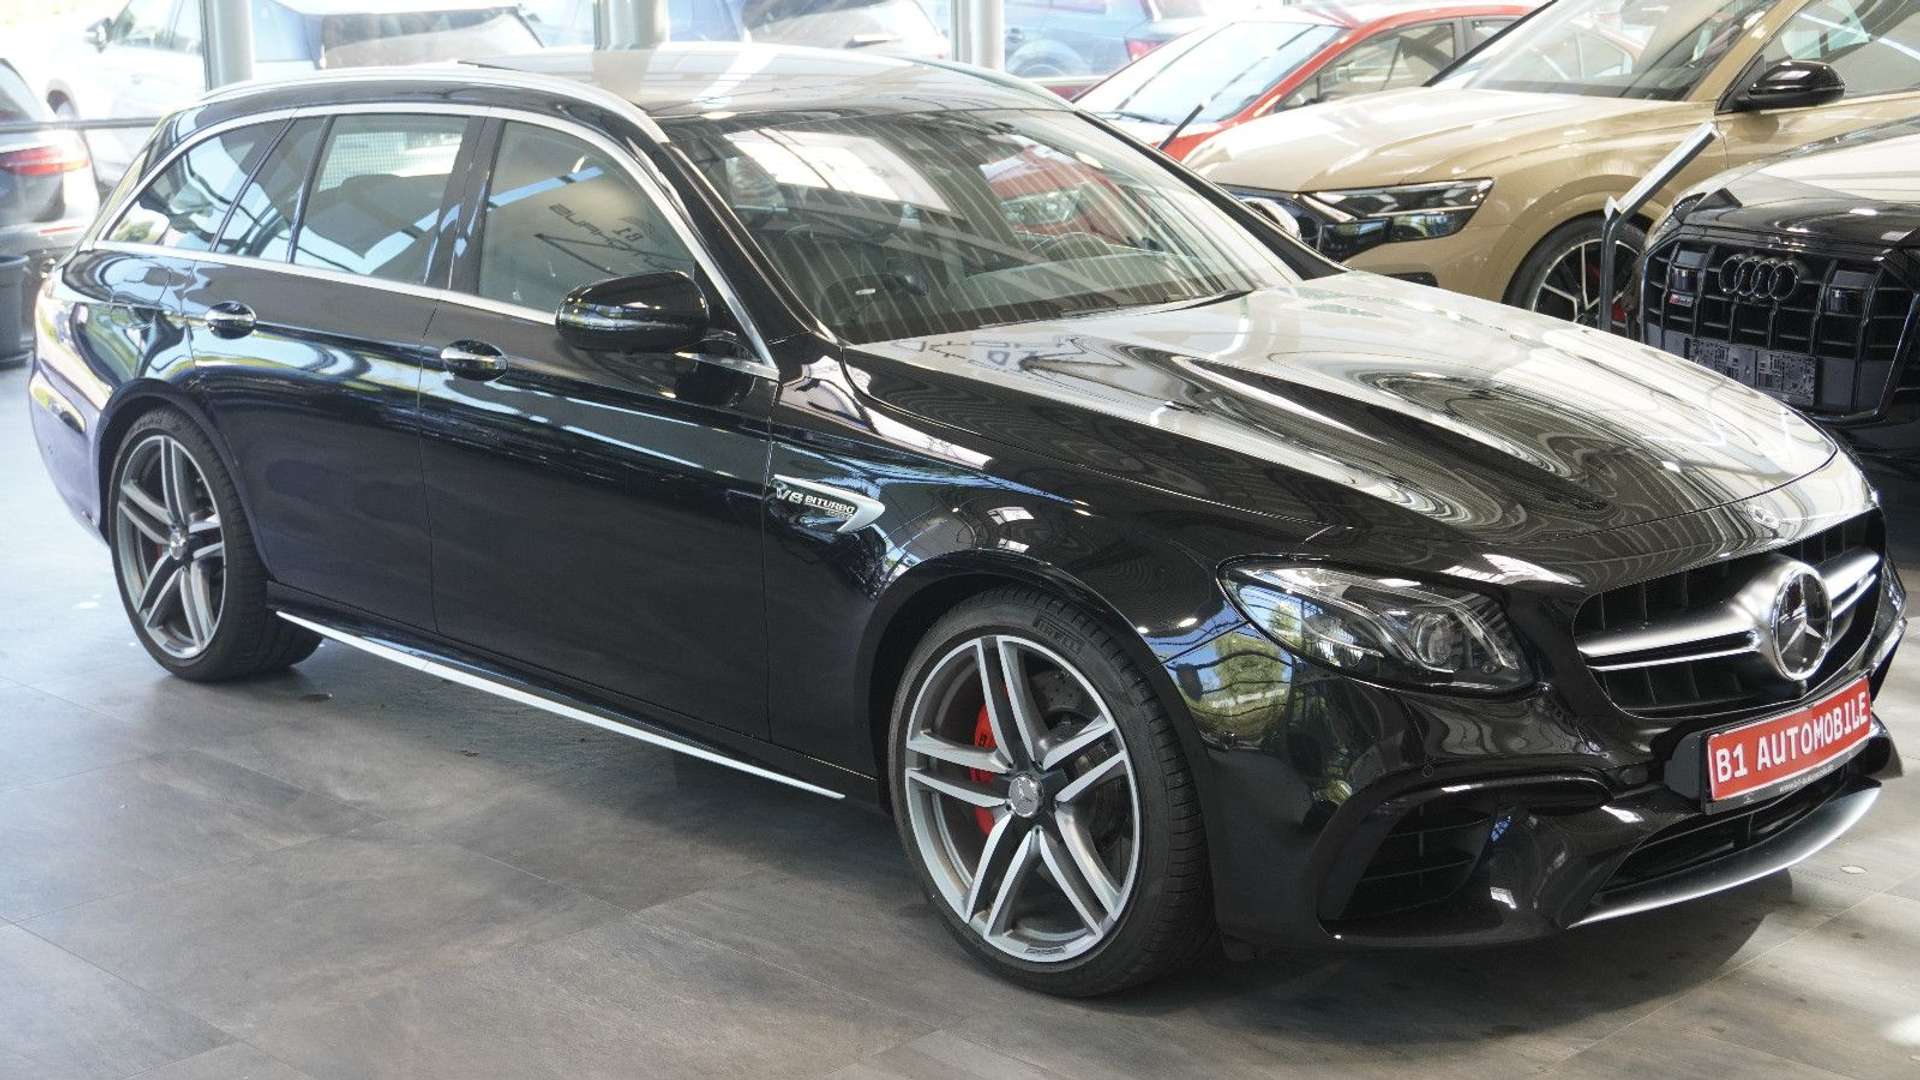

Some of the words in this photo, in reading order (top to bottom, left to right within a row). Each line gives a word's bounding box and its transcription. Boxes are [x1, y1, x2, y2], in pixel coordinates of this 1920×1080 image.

[776, 486, 803, 504] V8
[804, 495, 855, 513] BITURBO
[1715, 743, 1748, 783] B1
[1757, 691, 1868, 771] AUTOMOBILE
